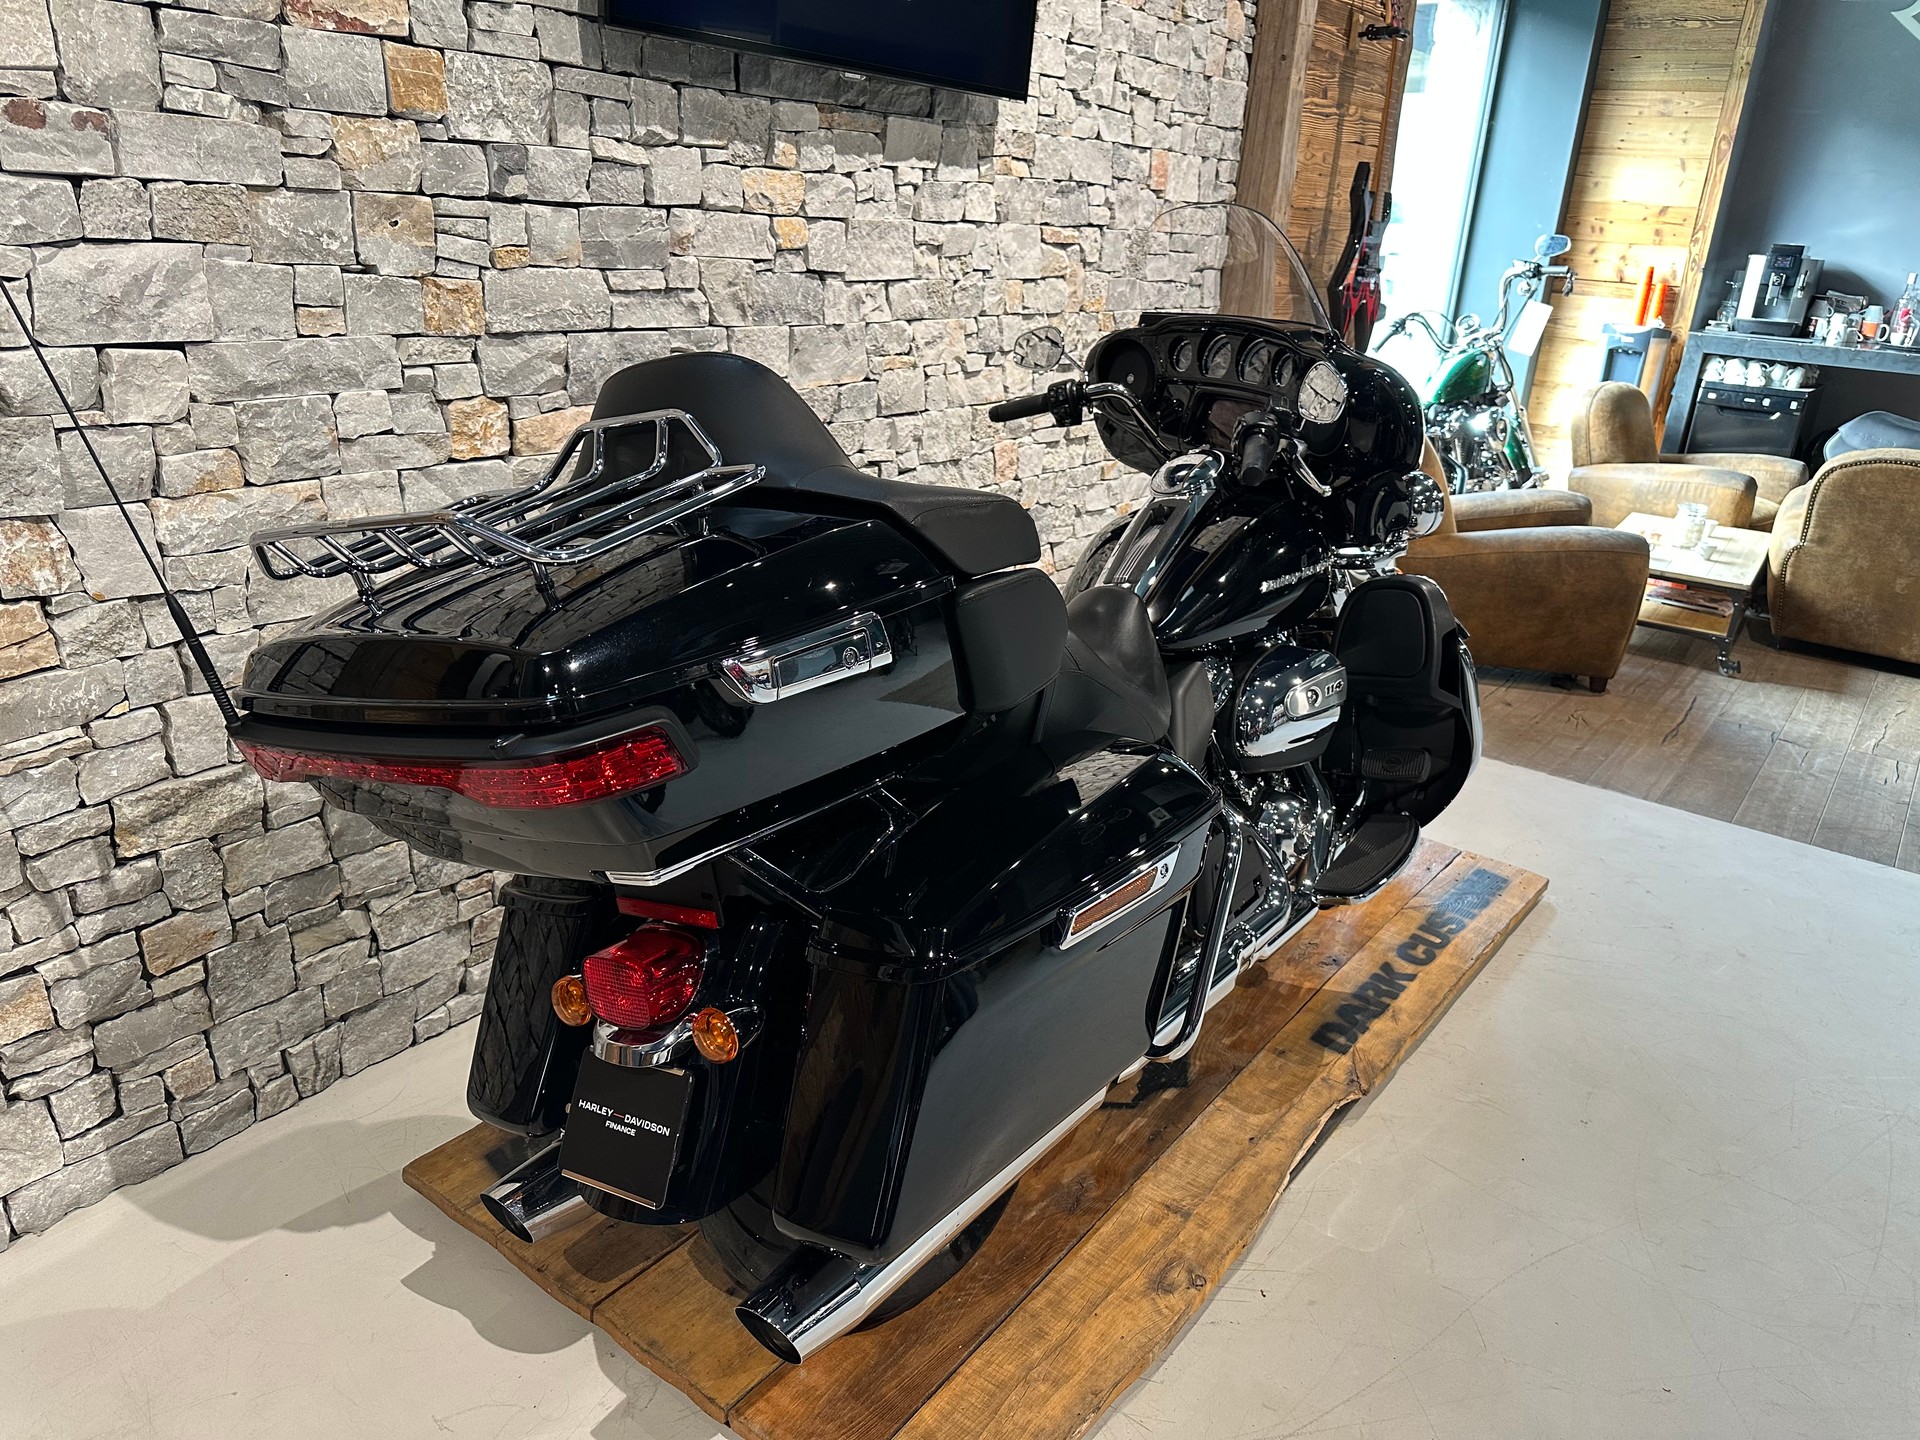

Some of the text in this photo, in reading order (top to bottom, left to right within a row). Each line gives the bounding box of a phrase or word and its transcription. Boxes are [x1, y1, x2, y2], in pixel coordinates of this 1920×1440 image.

[1324, 679, 1344, 697] 114
[1310, 868, 1510, 1056] DARK CUST
[605, 1120, 637, 1137] FINANCE
